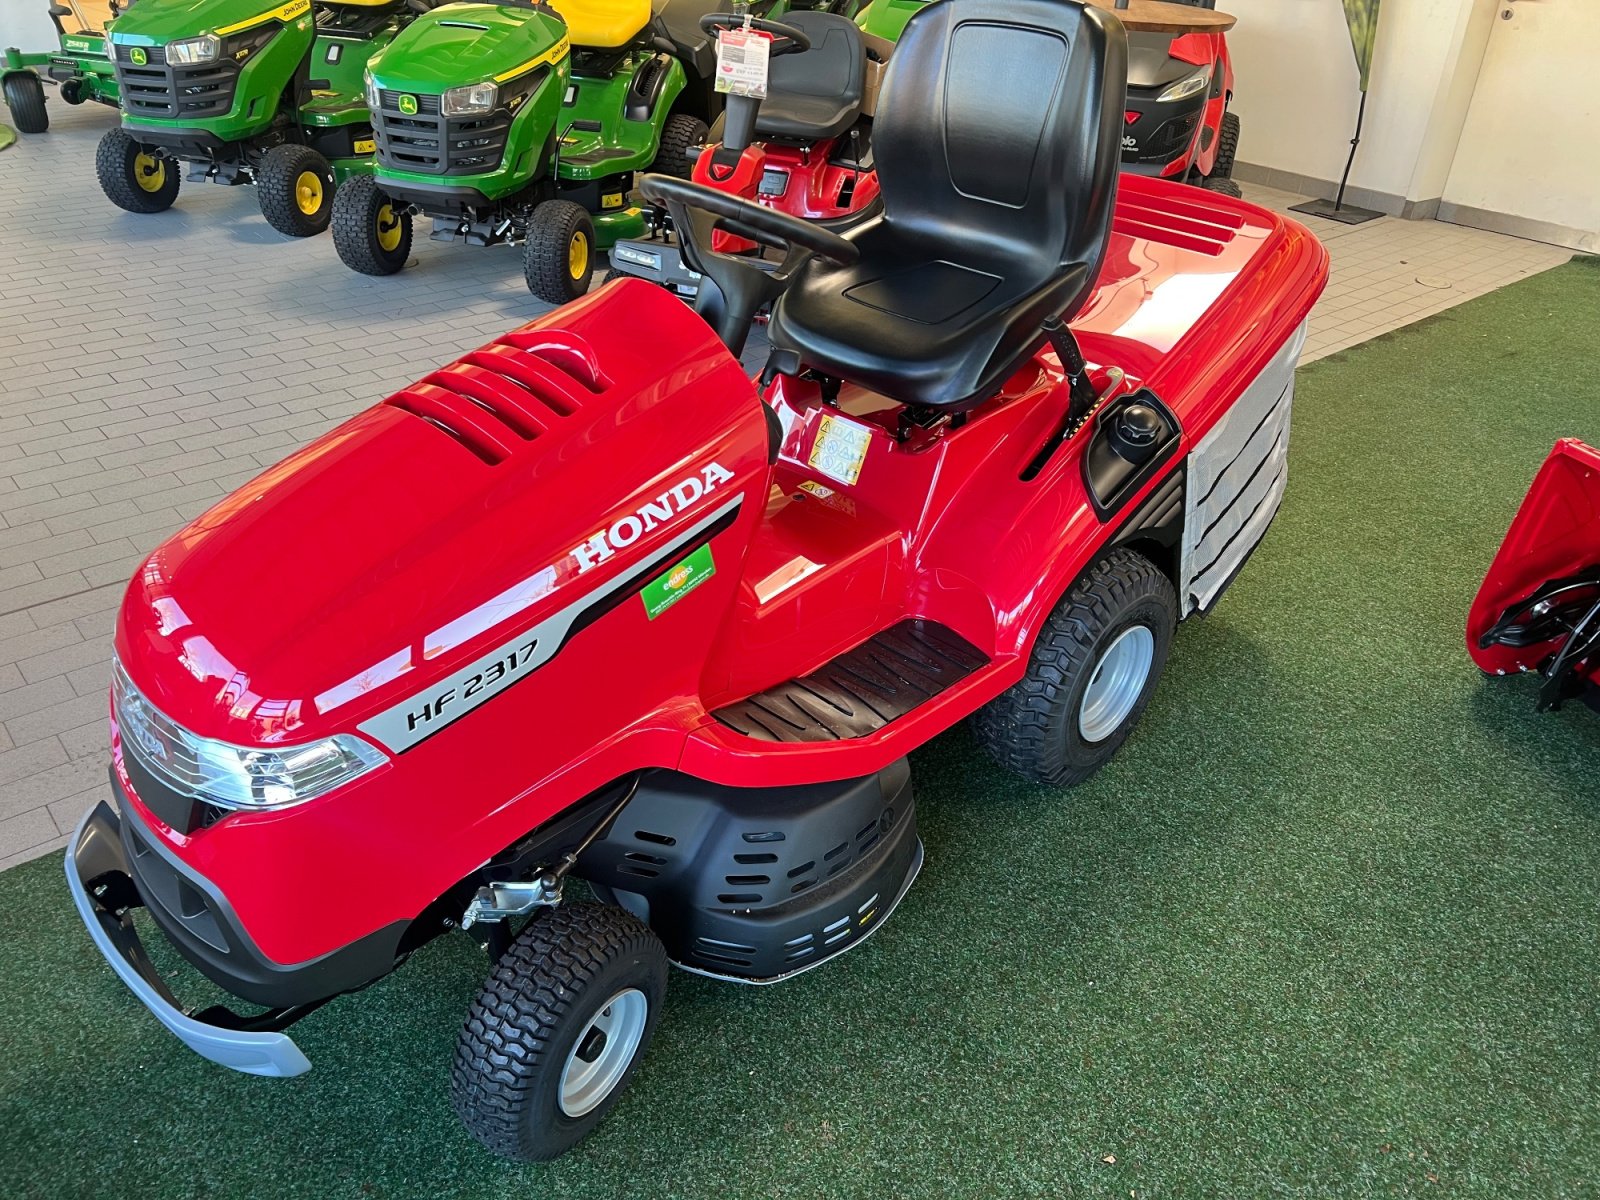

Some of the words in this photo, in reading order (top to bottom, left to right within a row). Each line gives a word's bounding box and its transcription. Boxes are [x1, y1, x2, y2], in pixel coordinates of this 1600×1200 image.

[283, 7, 295, 16] JOHN
[570, 461, 735, 575] HONDA
[662, 564, 694, 591] endress
[406, 688, 457, 732] HF
[462, 637, 540, 700] 2317
